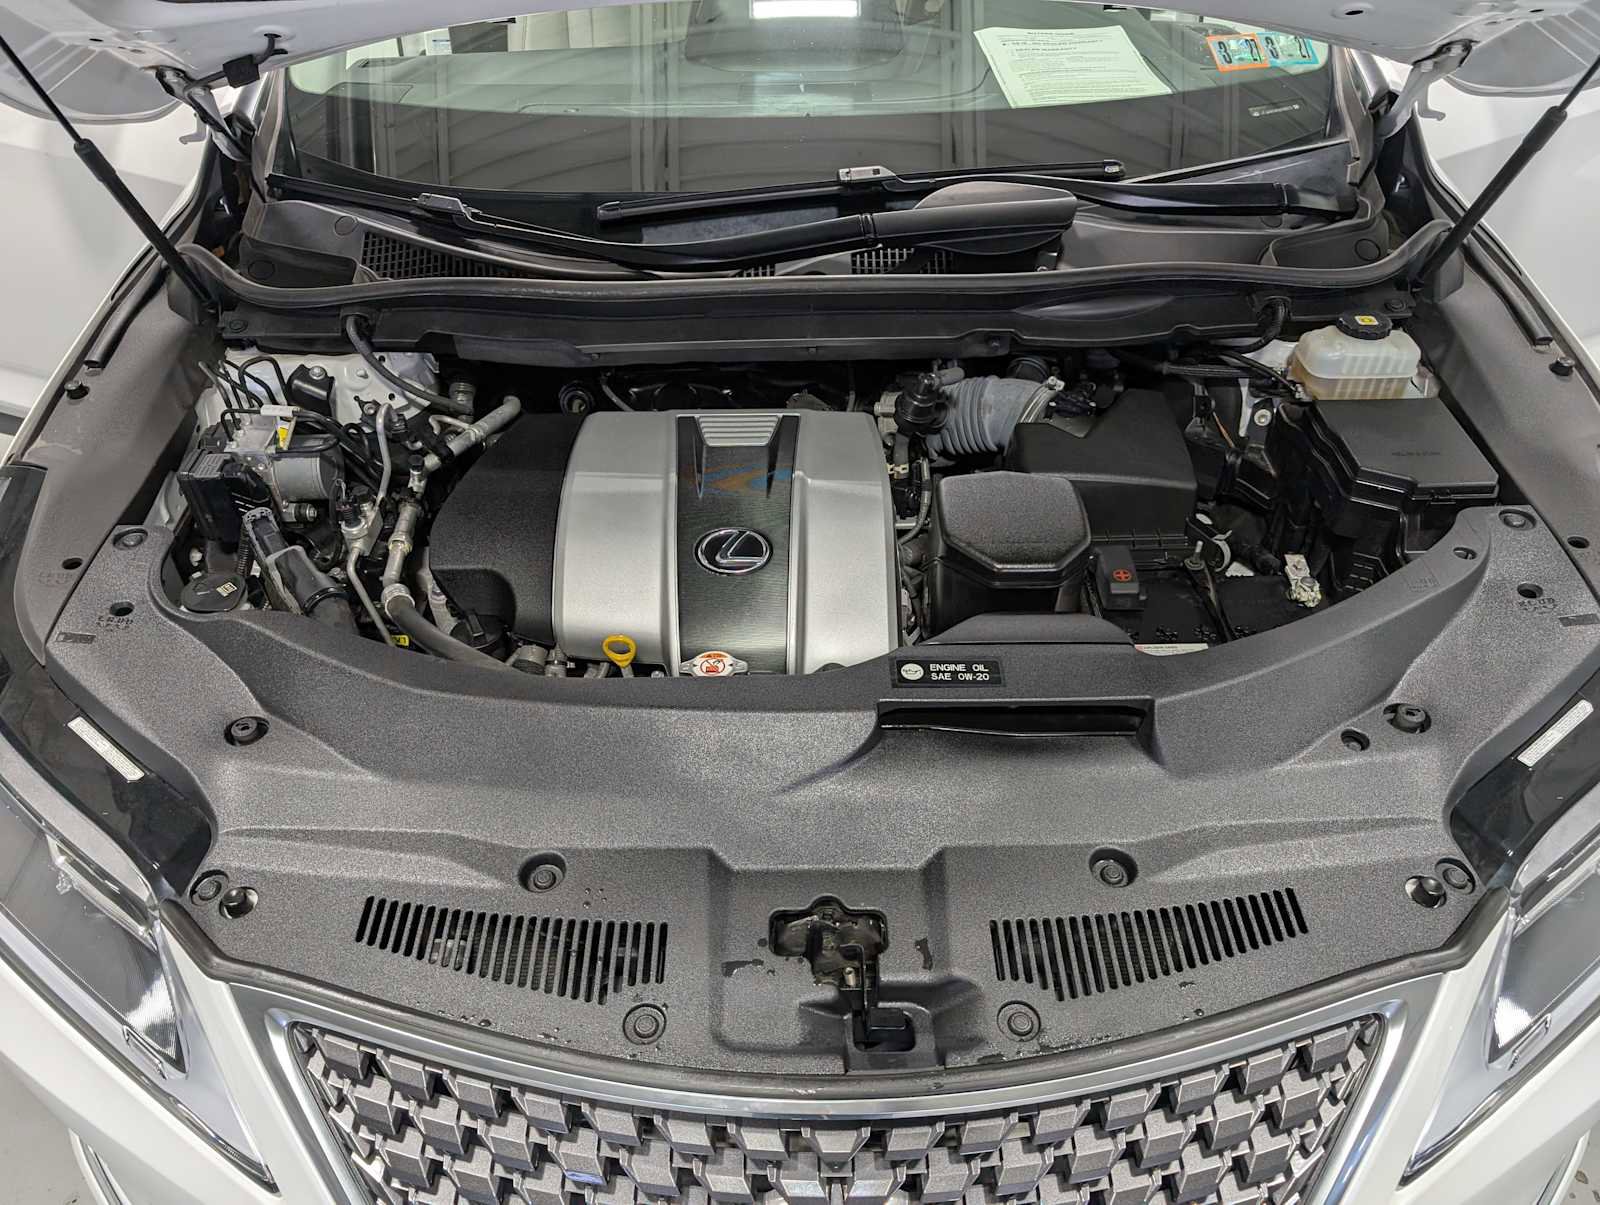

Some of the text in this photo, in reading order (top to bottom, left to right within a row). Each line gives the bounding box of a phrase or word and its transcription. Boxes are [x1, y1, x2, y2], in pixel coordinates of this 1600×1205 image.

[1217, 41, 1233, 65] 3
[1265, 36, 1280, 60] 3
[929, 663, 989, 672] ENGINE OIL
[930, 672, 990, 681] SAE 0W-20
